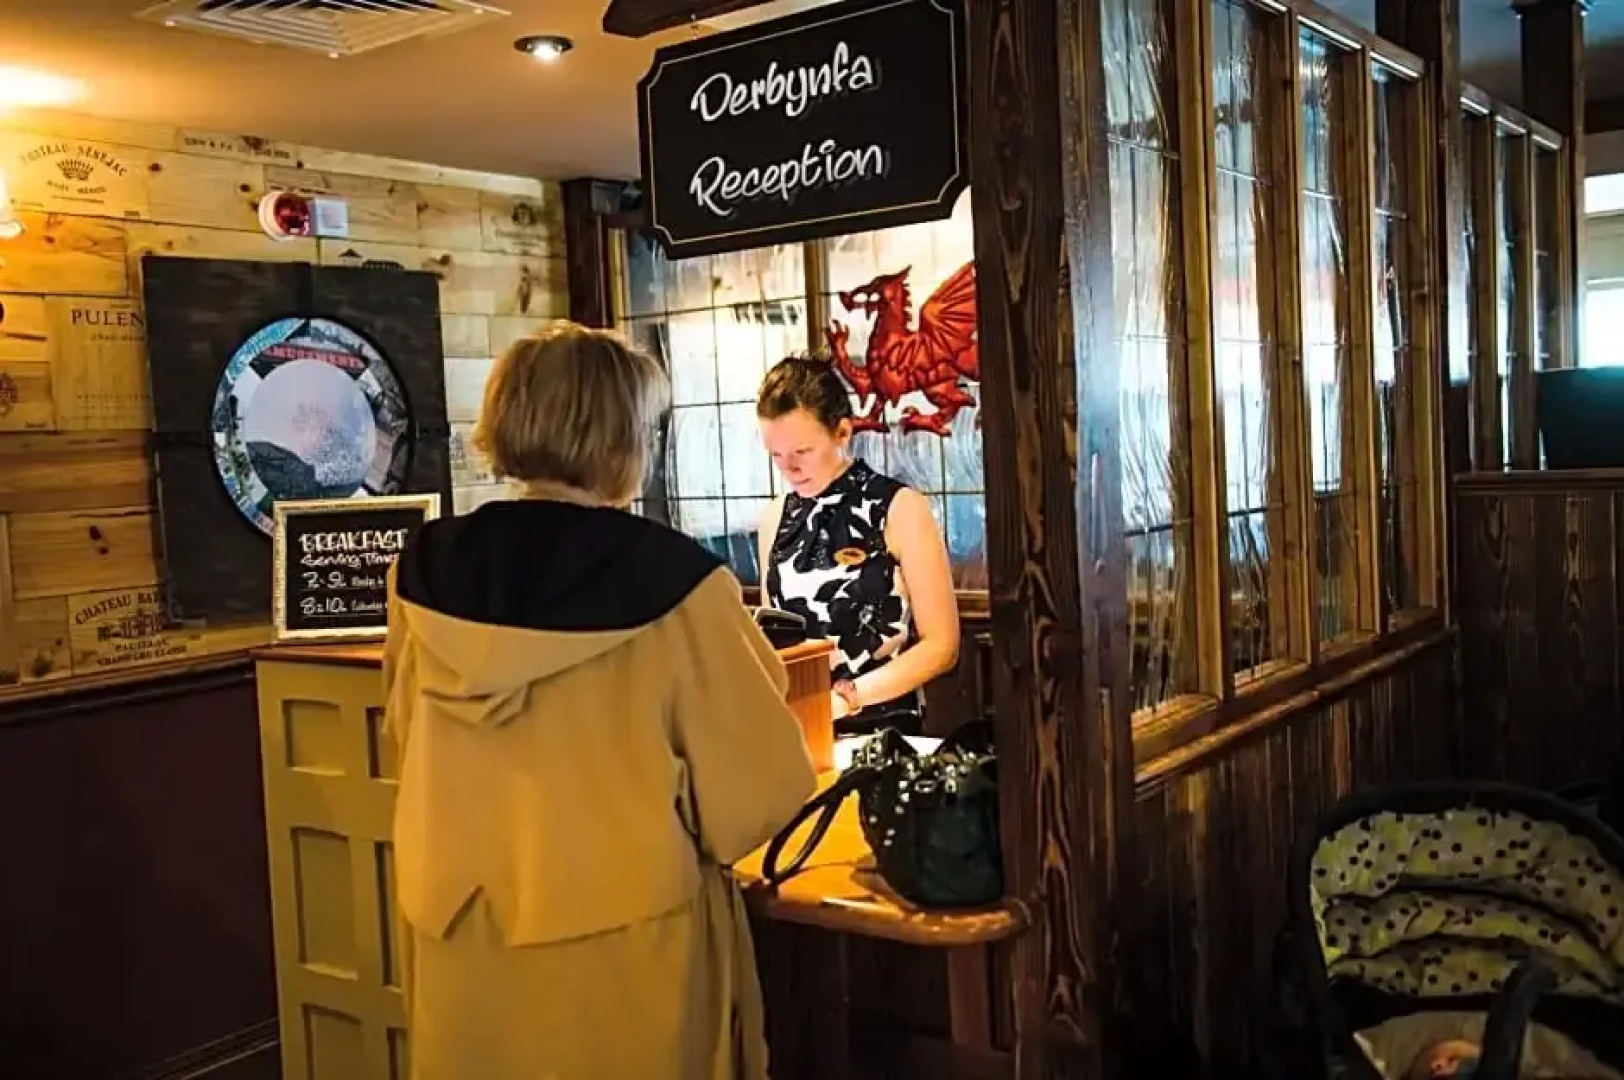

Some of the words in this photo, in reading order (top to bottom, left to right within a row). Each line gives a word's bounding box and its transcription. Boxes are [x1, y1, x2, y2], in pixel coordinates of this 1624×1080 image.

[690, 41, 873, 121] Derbynfa
[689, 139, 883, 216] Reception
[299, 528, 408, 553] BREAKFAST
